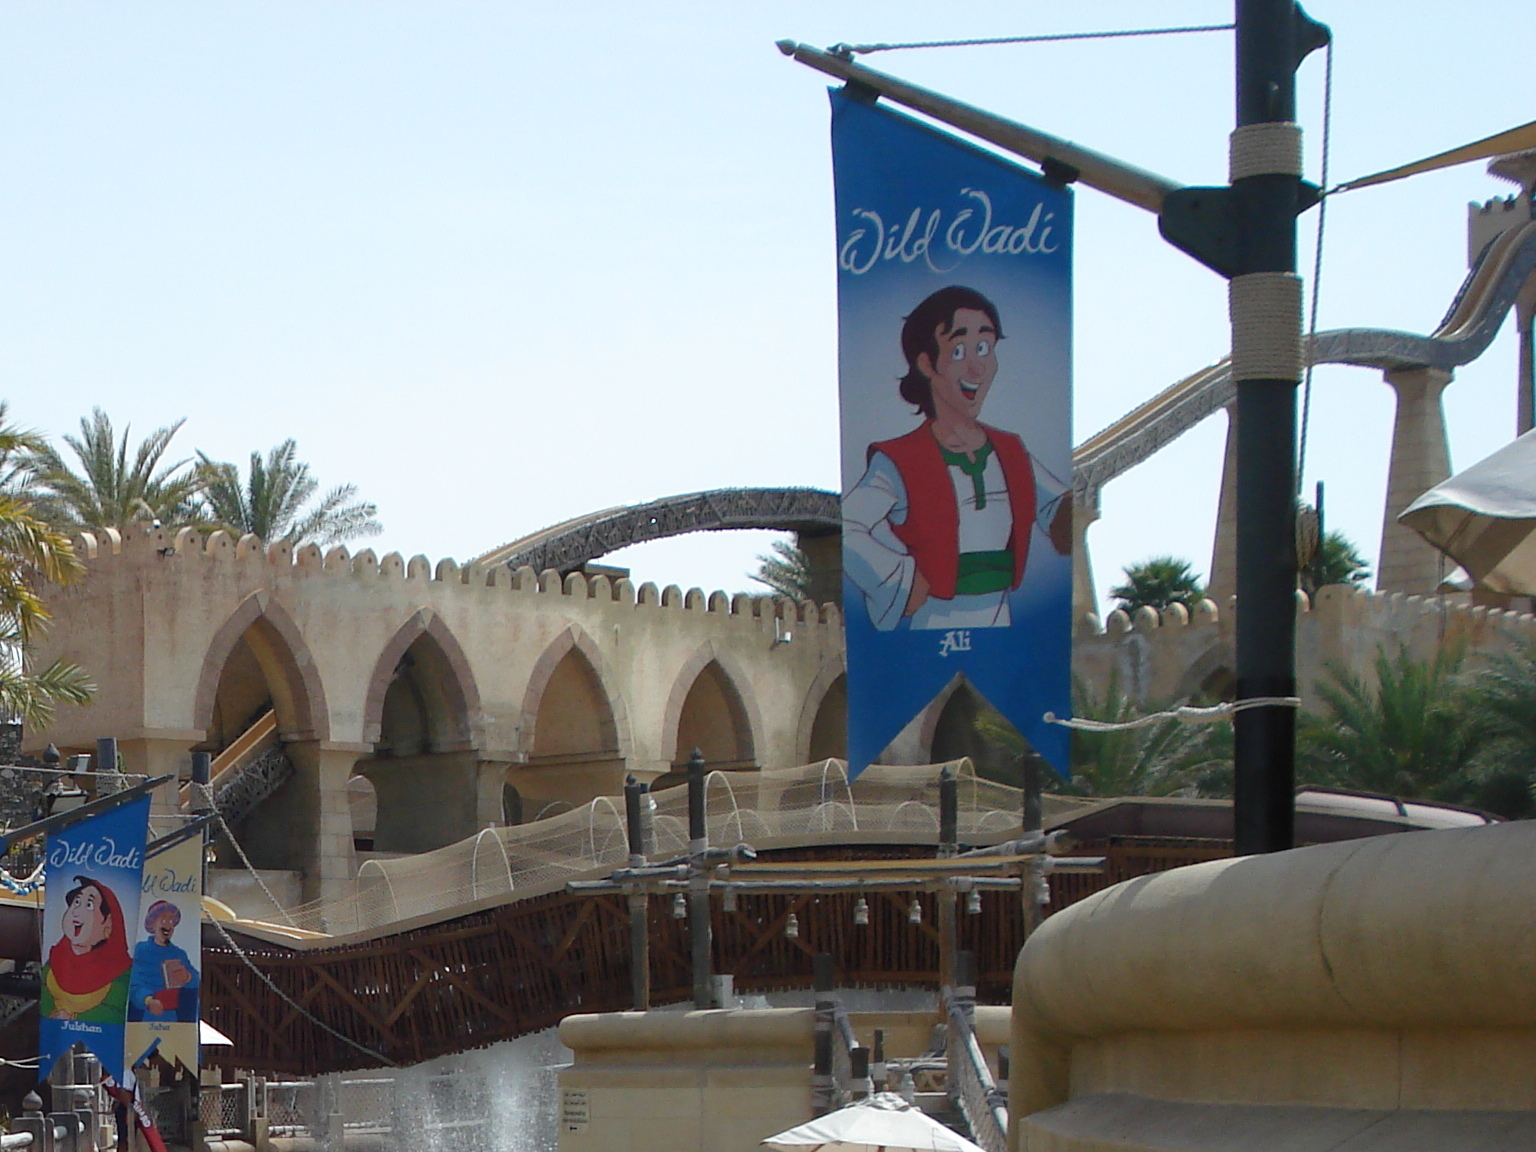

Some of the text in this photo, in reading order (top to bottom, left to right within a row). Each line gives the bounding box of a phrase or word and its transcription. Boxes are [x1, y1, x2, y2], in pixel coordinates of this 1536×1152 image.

[840, 187, 1059, 275] Wild Wadi
[939, 630, 972, 657] Ali
[50, 836, 141, 872] Wild Wadi
[159, 867, 197, 893] Wadi
